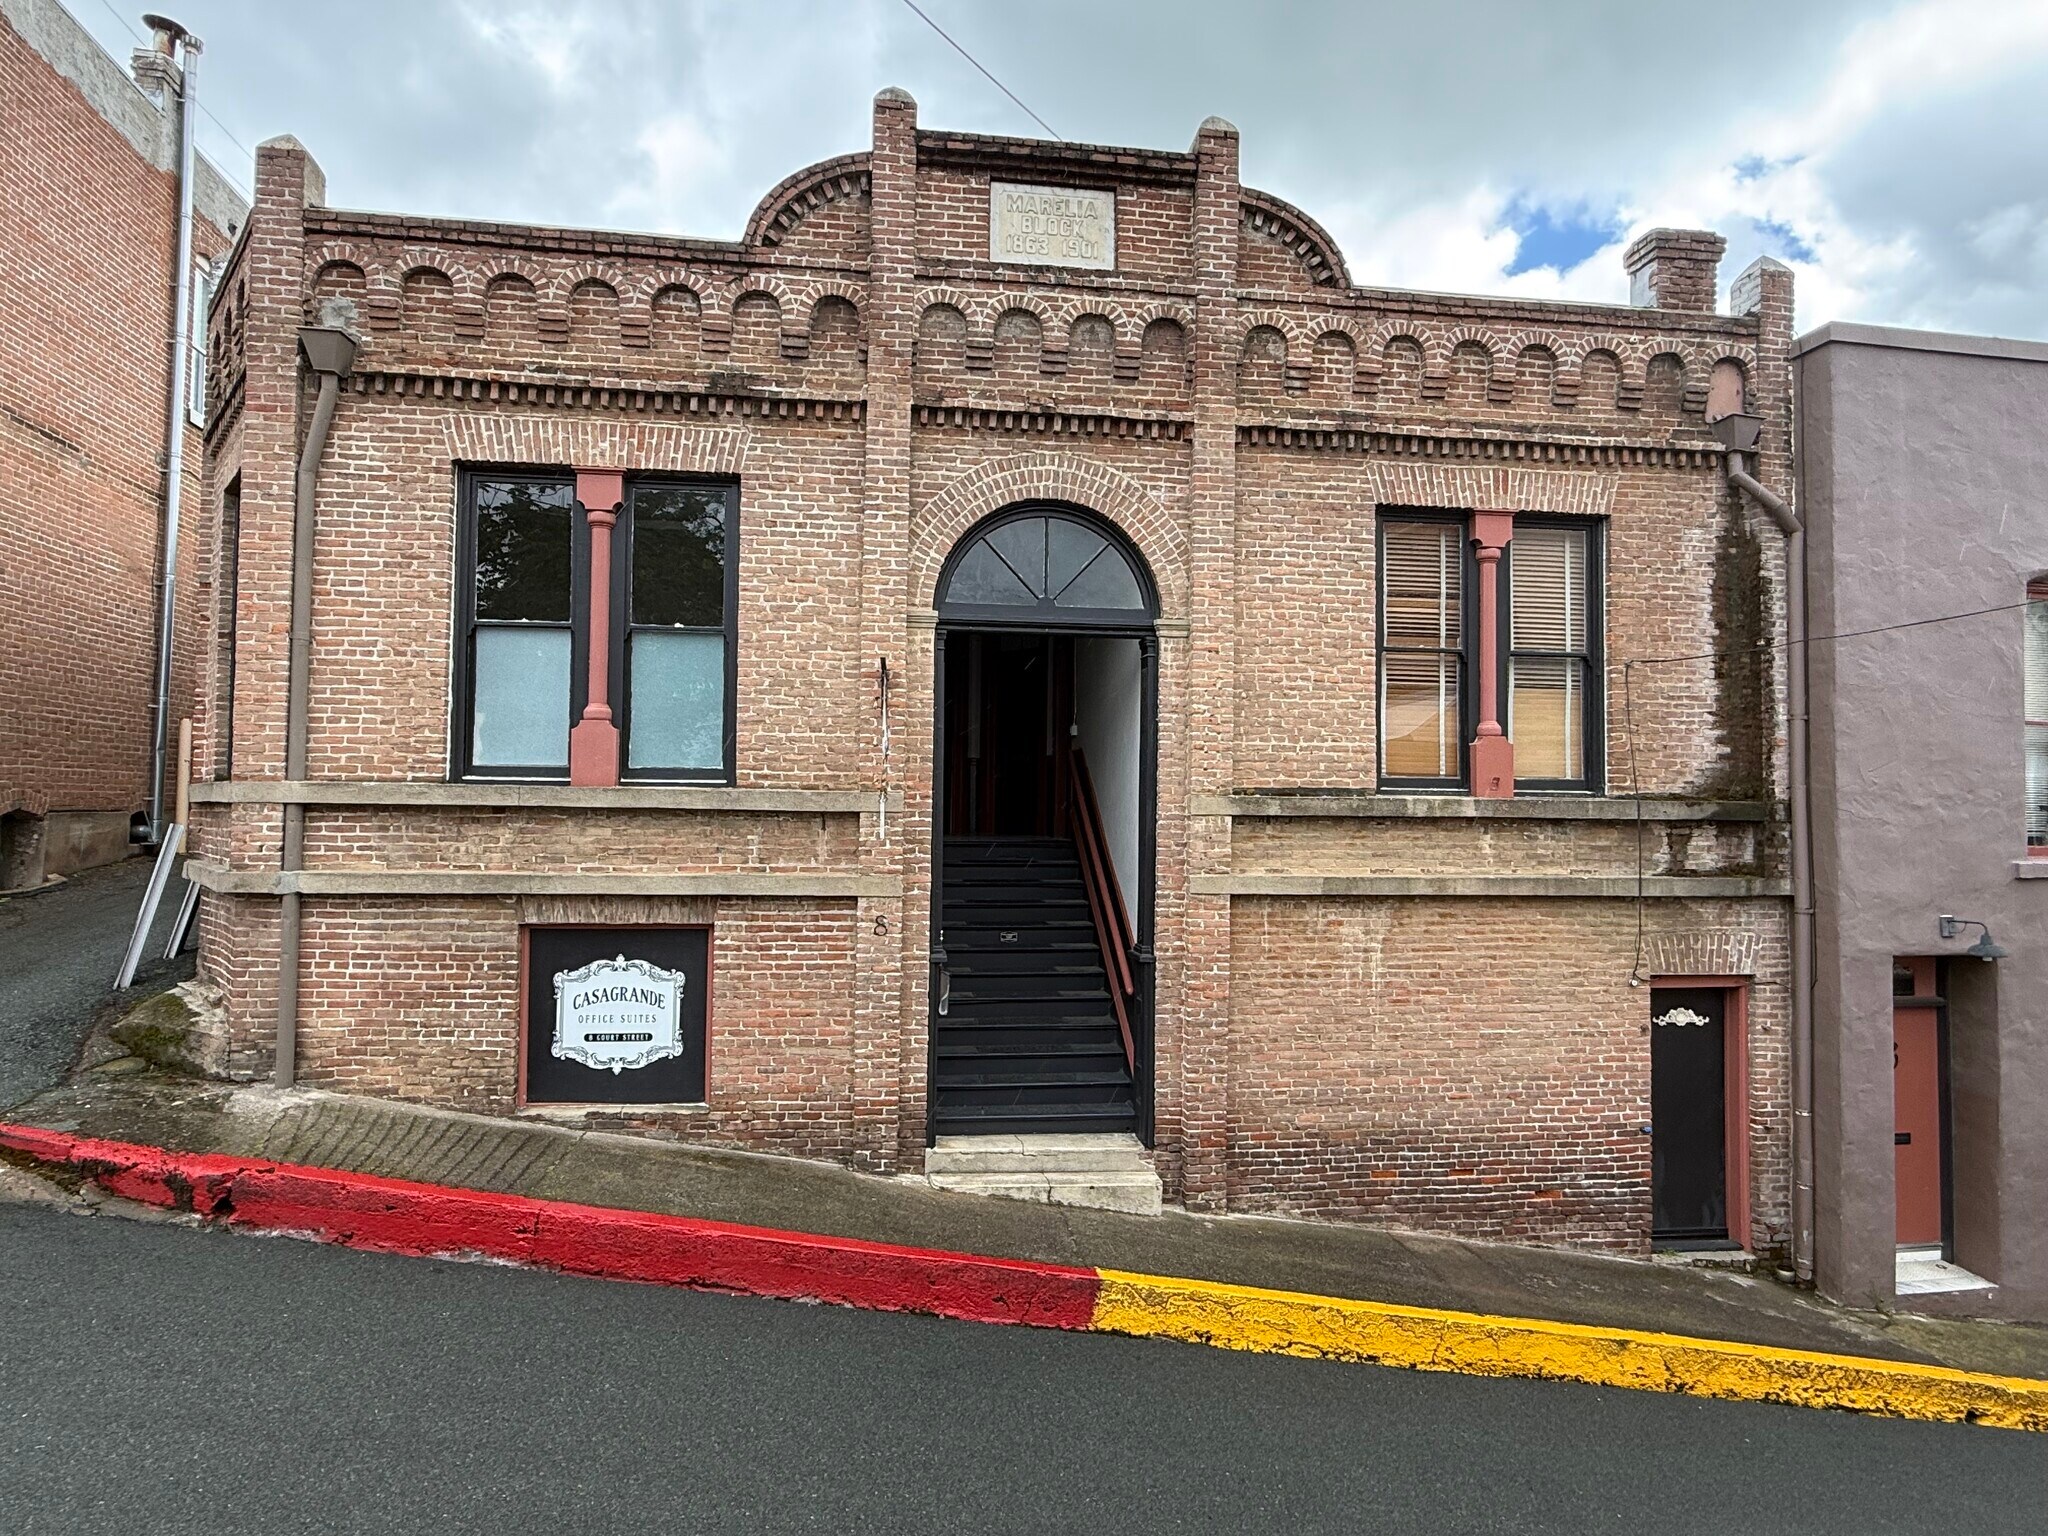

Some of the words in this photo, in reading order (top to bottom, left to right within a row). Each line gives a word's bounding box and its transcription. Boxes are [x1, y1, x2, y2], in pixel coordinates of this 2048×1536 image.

[1006, 194, 1098, 220] MARELIA
[1021, 215, 1084, 238] BLOCK
[1006, 234, 1049, 255] 1863
[1062, 238, 1099, 259] 1901
[573, 986, 666, 1010] CASAGRANDE
[578, 1014, 615, 1024] OFFICE
[620, 1014, 657, 1023] SUITES
[622, 1033, 649, 1041] STREET
